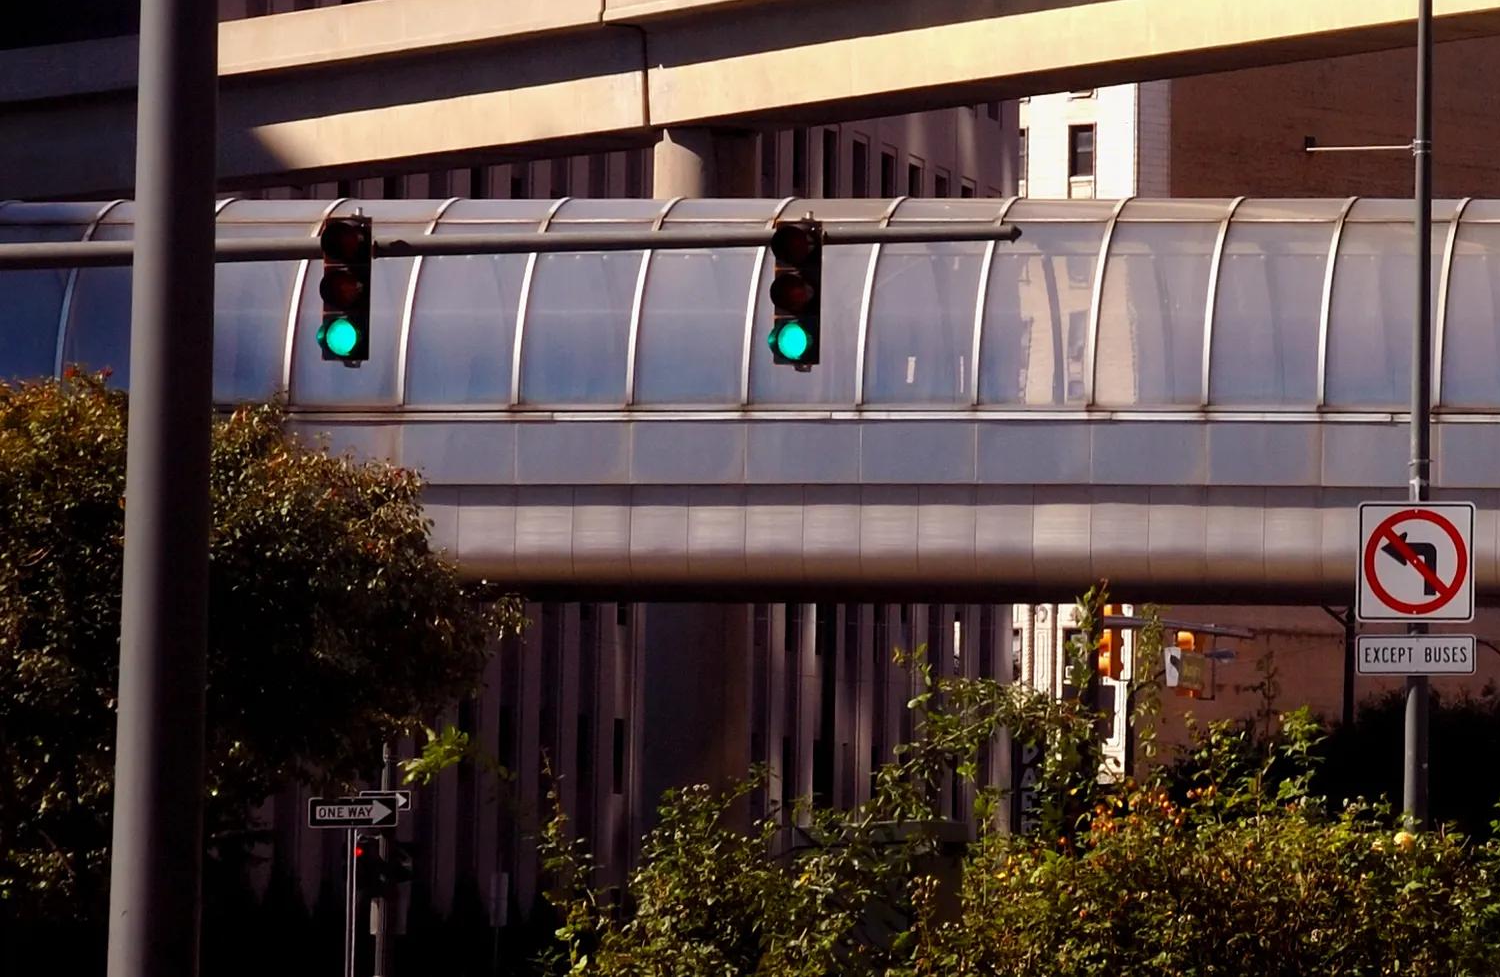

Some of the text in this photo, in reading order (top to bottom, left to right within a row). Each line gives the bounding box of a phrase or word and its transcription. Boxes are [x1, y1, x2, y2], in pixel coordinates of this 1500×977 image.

[1364, 646, 1468, 664] EXCEPT BUSES
[319, 805, 373, 819] ONE WAY
